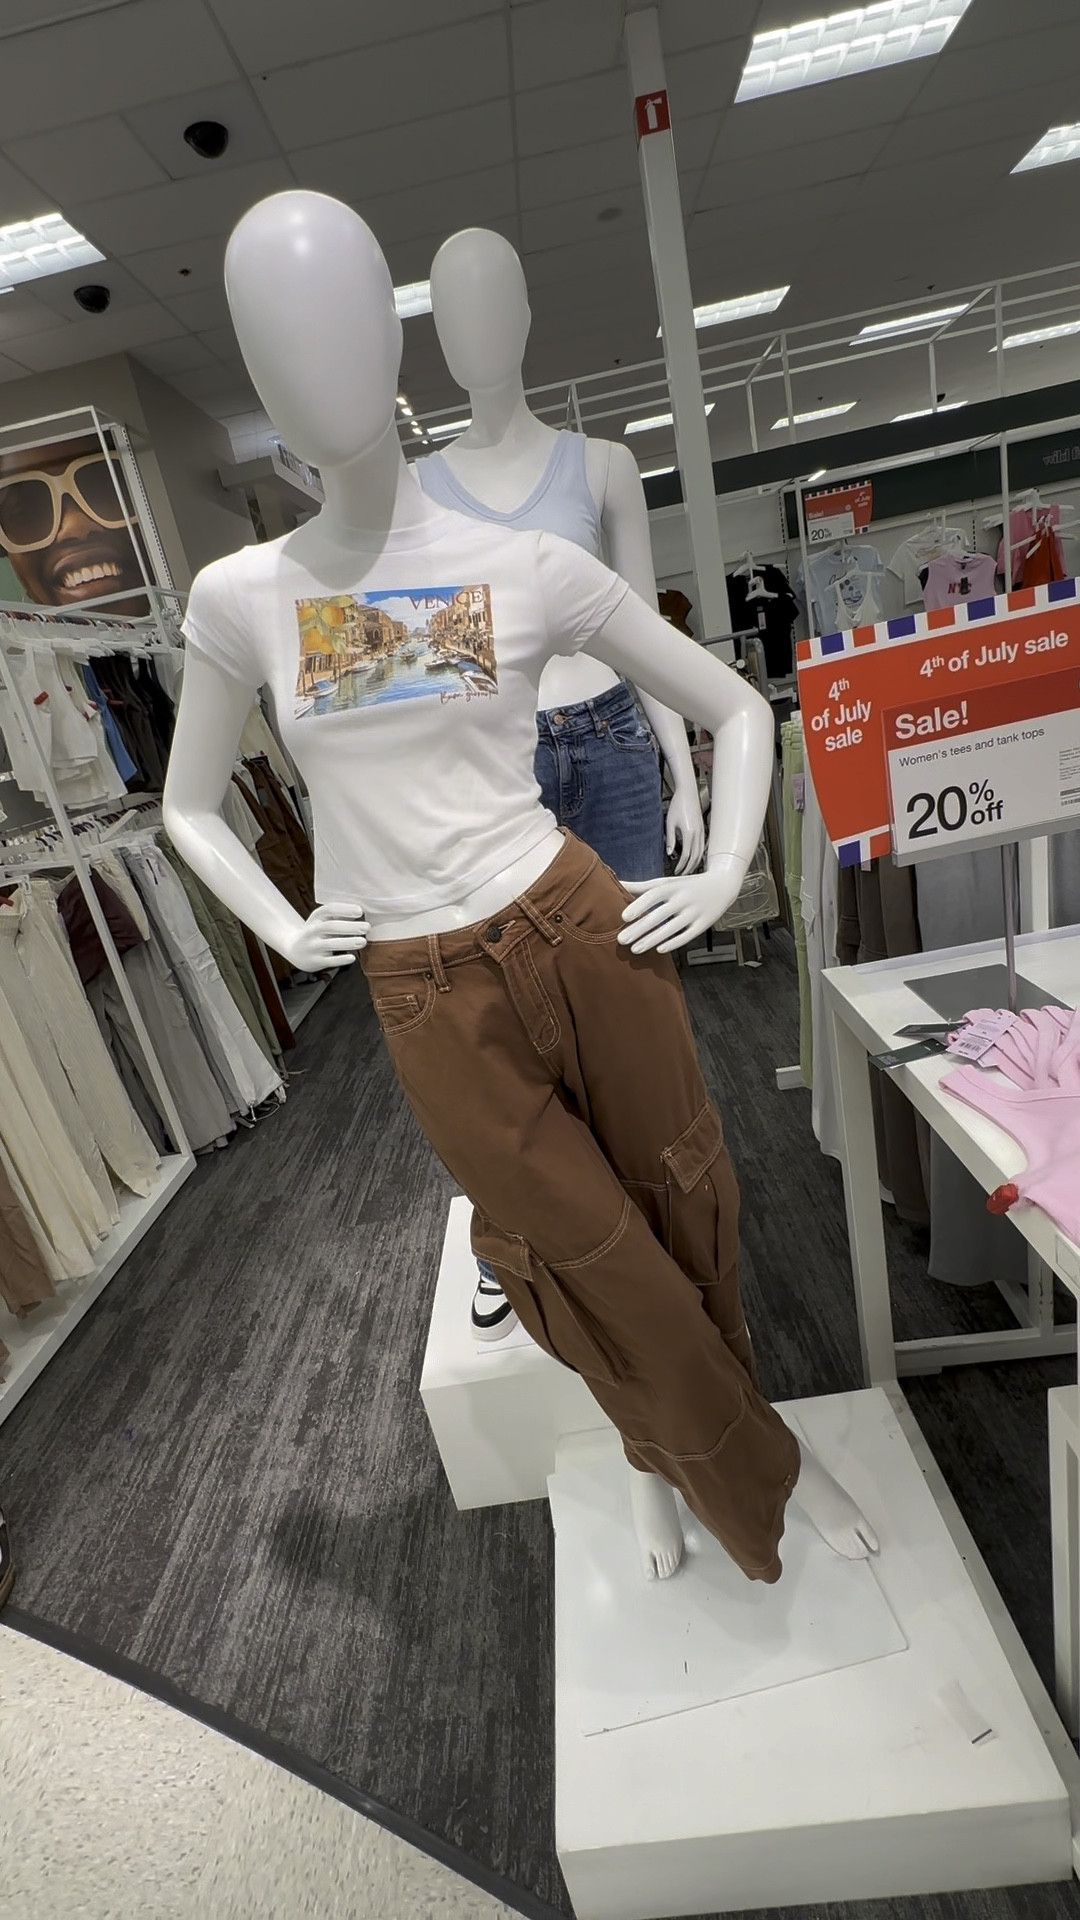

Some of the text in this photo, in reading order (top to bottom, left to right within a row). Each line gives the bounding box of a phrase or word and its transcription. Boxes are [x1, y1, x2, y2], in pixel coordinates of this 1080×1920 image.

[811, 528, 825, 541] 20
[408, 590, 484, 611] VENICE
[919, 629, 1070, 677] 4th of July sale
[828, 677, 850, 701] 4th
[811, 699, 872, 732] of July
[895, 700, 969, 740] Sale!
[824, 726, 863, 752] sale
[899, 726, 1045, 768] Women's tees and tank tops
[906, 785, 968, 840] 20
[970, 800, 1004, 826] off
